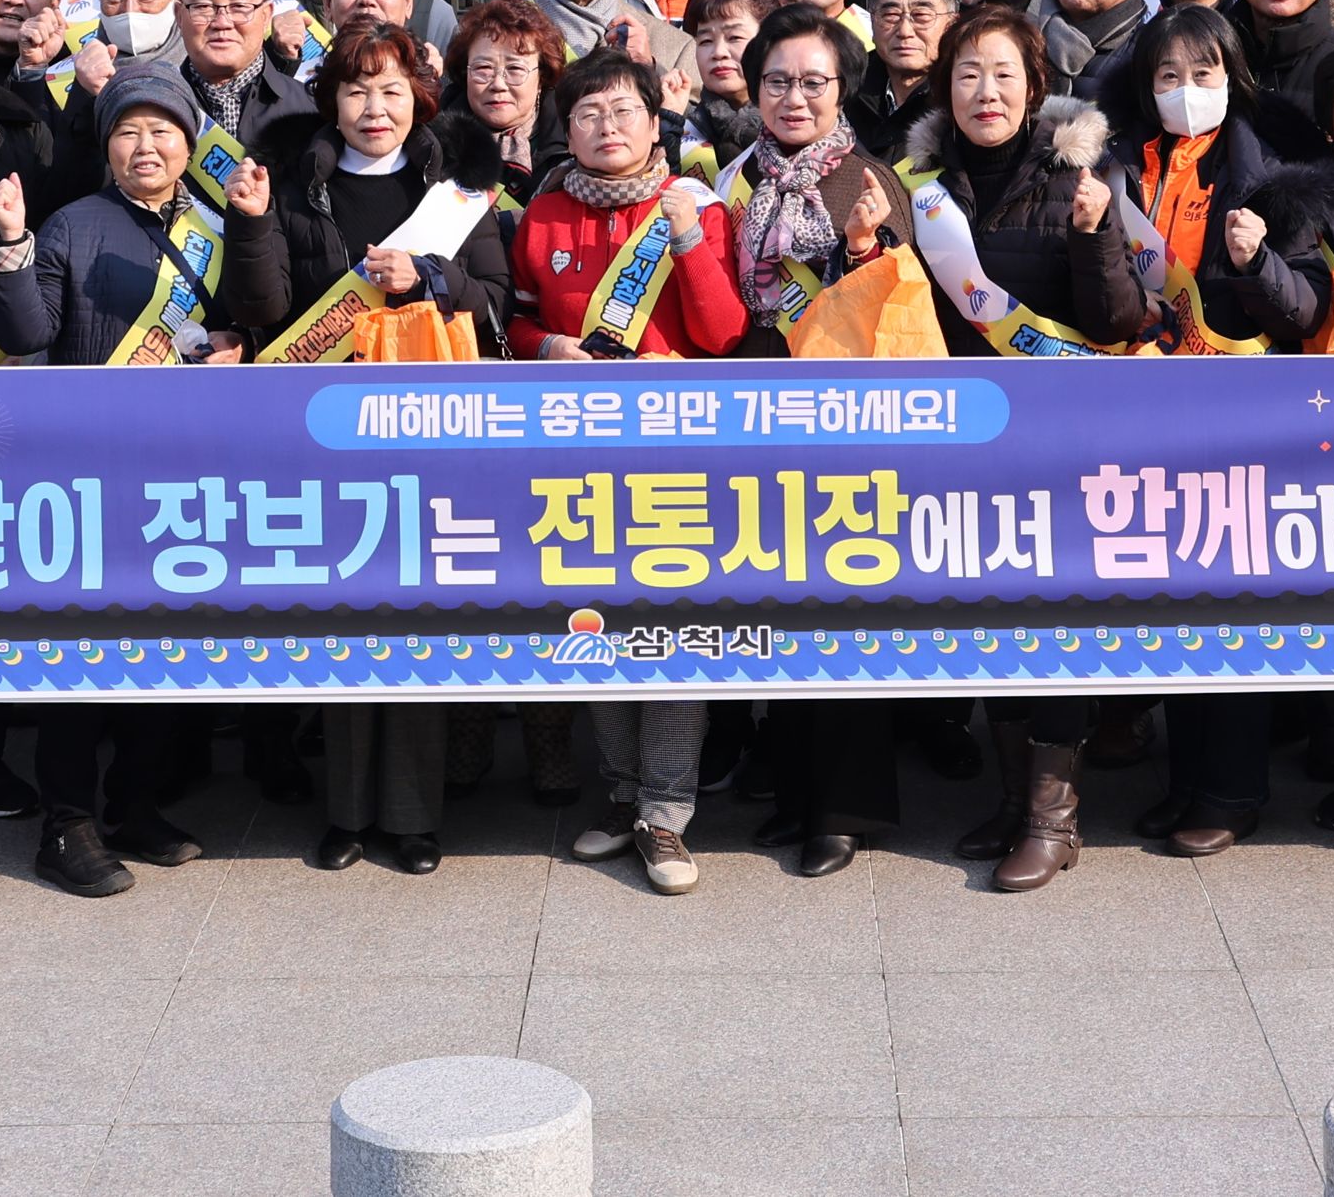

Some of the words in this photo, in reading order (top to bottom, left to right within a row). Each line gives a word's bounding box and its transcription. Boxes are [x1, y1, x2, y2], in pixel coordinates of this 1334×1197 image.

[599, 216, 673, 332] 전통시장을
[355, 393, 527, 439] 새해에는
[539, 392, 624, 438] 좋은
[637, 391, 721, 436] 일만
[732, 388, 957, 435] 가득하세요!
[141, 472, 498, 591] 장보기는
[527, 468, 1054, 589] 전통시장에서
[624, 626, 772, 659] 삼척시
